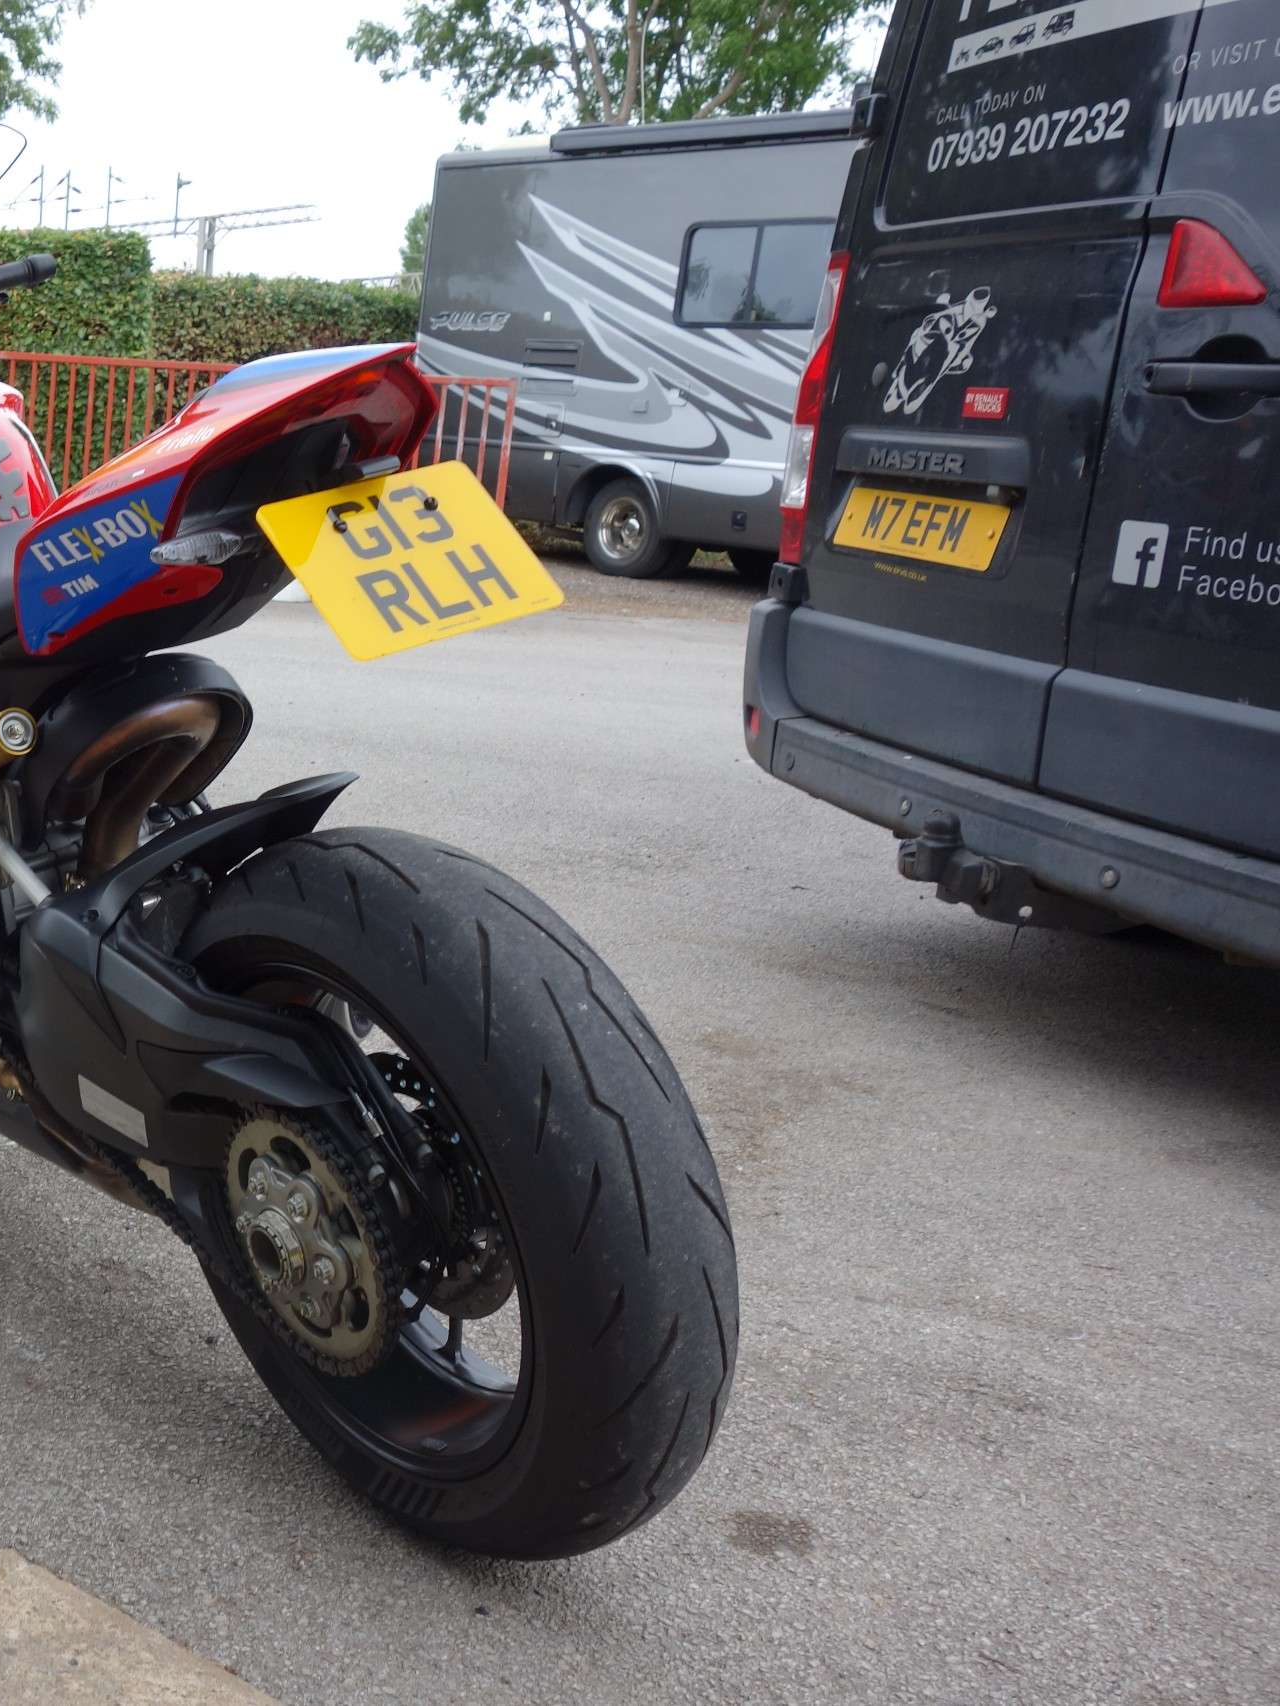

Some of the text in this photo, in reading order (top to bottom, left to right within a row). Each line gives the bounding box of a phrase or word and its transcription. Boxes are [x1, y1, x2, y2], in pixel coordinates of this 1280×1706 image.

[1173, 50, 1201, 74] OR
[1211, 39, 1267, 67] VISIT
[936, 83, 1047, 126] CALL TODAY ON
[927, 98, 1131, 173] 07939 207232
[868, 447, 965, 475] MASTER
[30, 499, 165, 573] FLEX-BOX
[325, 484, 455, 560] G13
[861, 496, 971, 553] M7 EFM
[1184, 526, 1248, 560] Find
[61, 573, 100, 599] TIM
[355, 543, 519, 634] RLH
